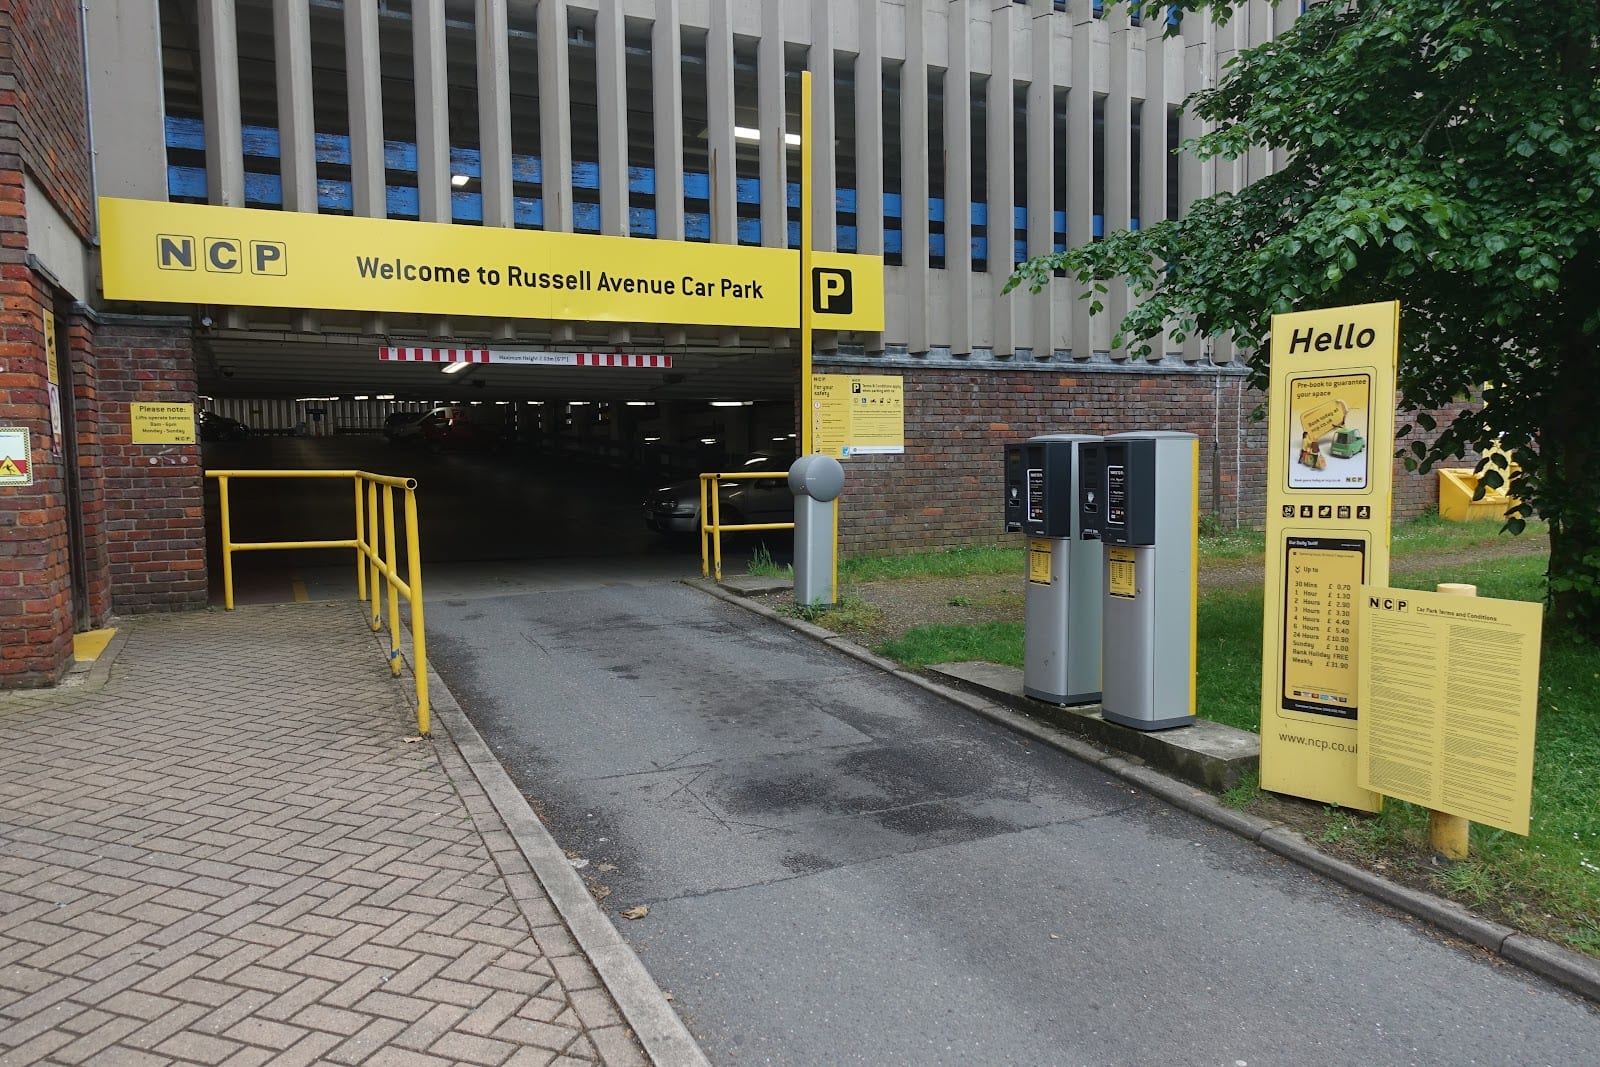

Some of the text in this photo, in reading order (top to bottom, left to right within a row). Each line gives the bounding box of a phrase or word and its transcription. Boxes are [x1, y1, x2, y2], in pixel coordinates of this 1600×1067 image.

[159, 236, 282, 272] NCP
[356, 256, 764, 299] Welcome to Russell Avenue Car Park
[818, 270, 847, 311] P
[1289, 322, 1376, 354] Hello
[1334, 379, 1366, 388] guarantee
[1369, 597, 1407, 611] NCP
[1468, 612, 1497, 621] Conditions
[1293, 640, 1314, 649] Sunday
[1309, 651, 1330, 659] Holiday
[1293, 657, 1312, 666] Weekly
